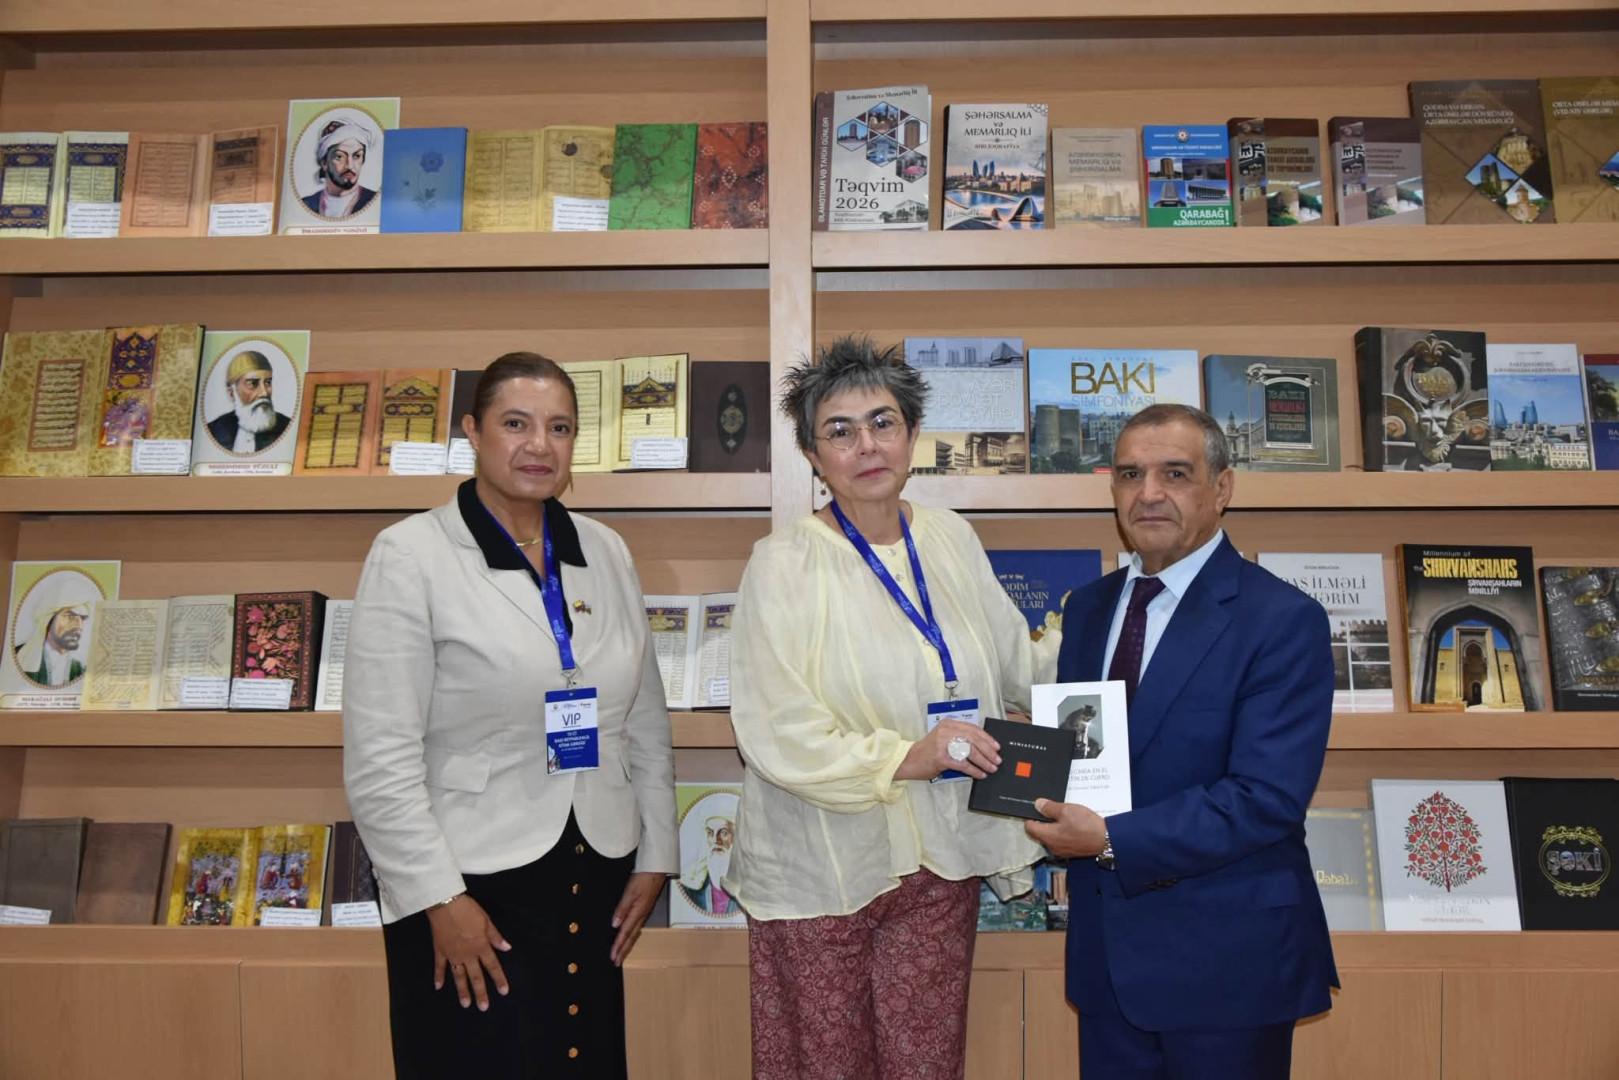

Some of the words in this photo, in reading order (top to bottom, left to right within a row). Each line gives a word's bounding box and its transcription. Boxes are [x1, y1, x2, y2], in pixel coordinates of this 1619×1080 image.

[964, 111, 1033, 120] ŞƏHƏRSALMA
[964, 128, 1018, 138] MEMARLIQ
[1020, 127, 1032, 136] İLİ
[820, 169, 828, 179] VƏ
[836, 178, 904, 196] Təqvim
[818, 180, 827, 223] ƏLAMƏTDAR
[836, 198, 880, 209] 2026
[1071, 362, 1155, 394] BAKI
[1423, 558, 1518, 579] SHIRVANSHAHS
[1312, 574, 1366, 590] İLMƏLİ
[562, 712, 581, 726] VIP
